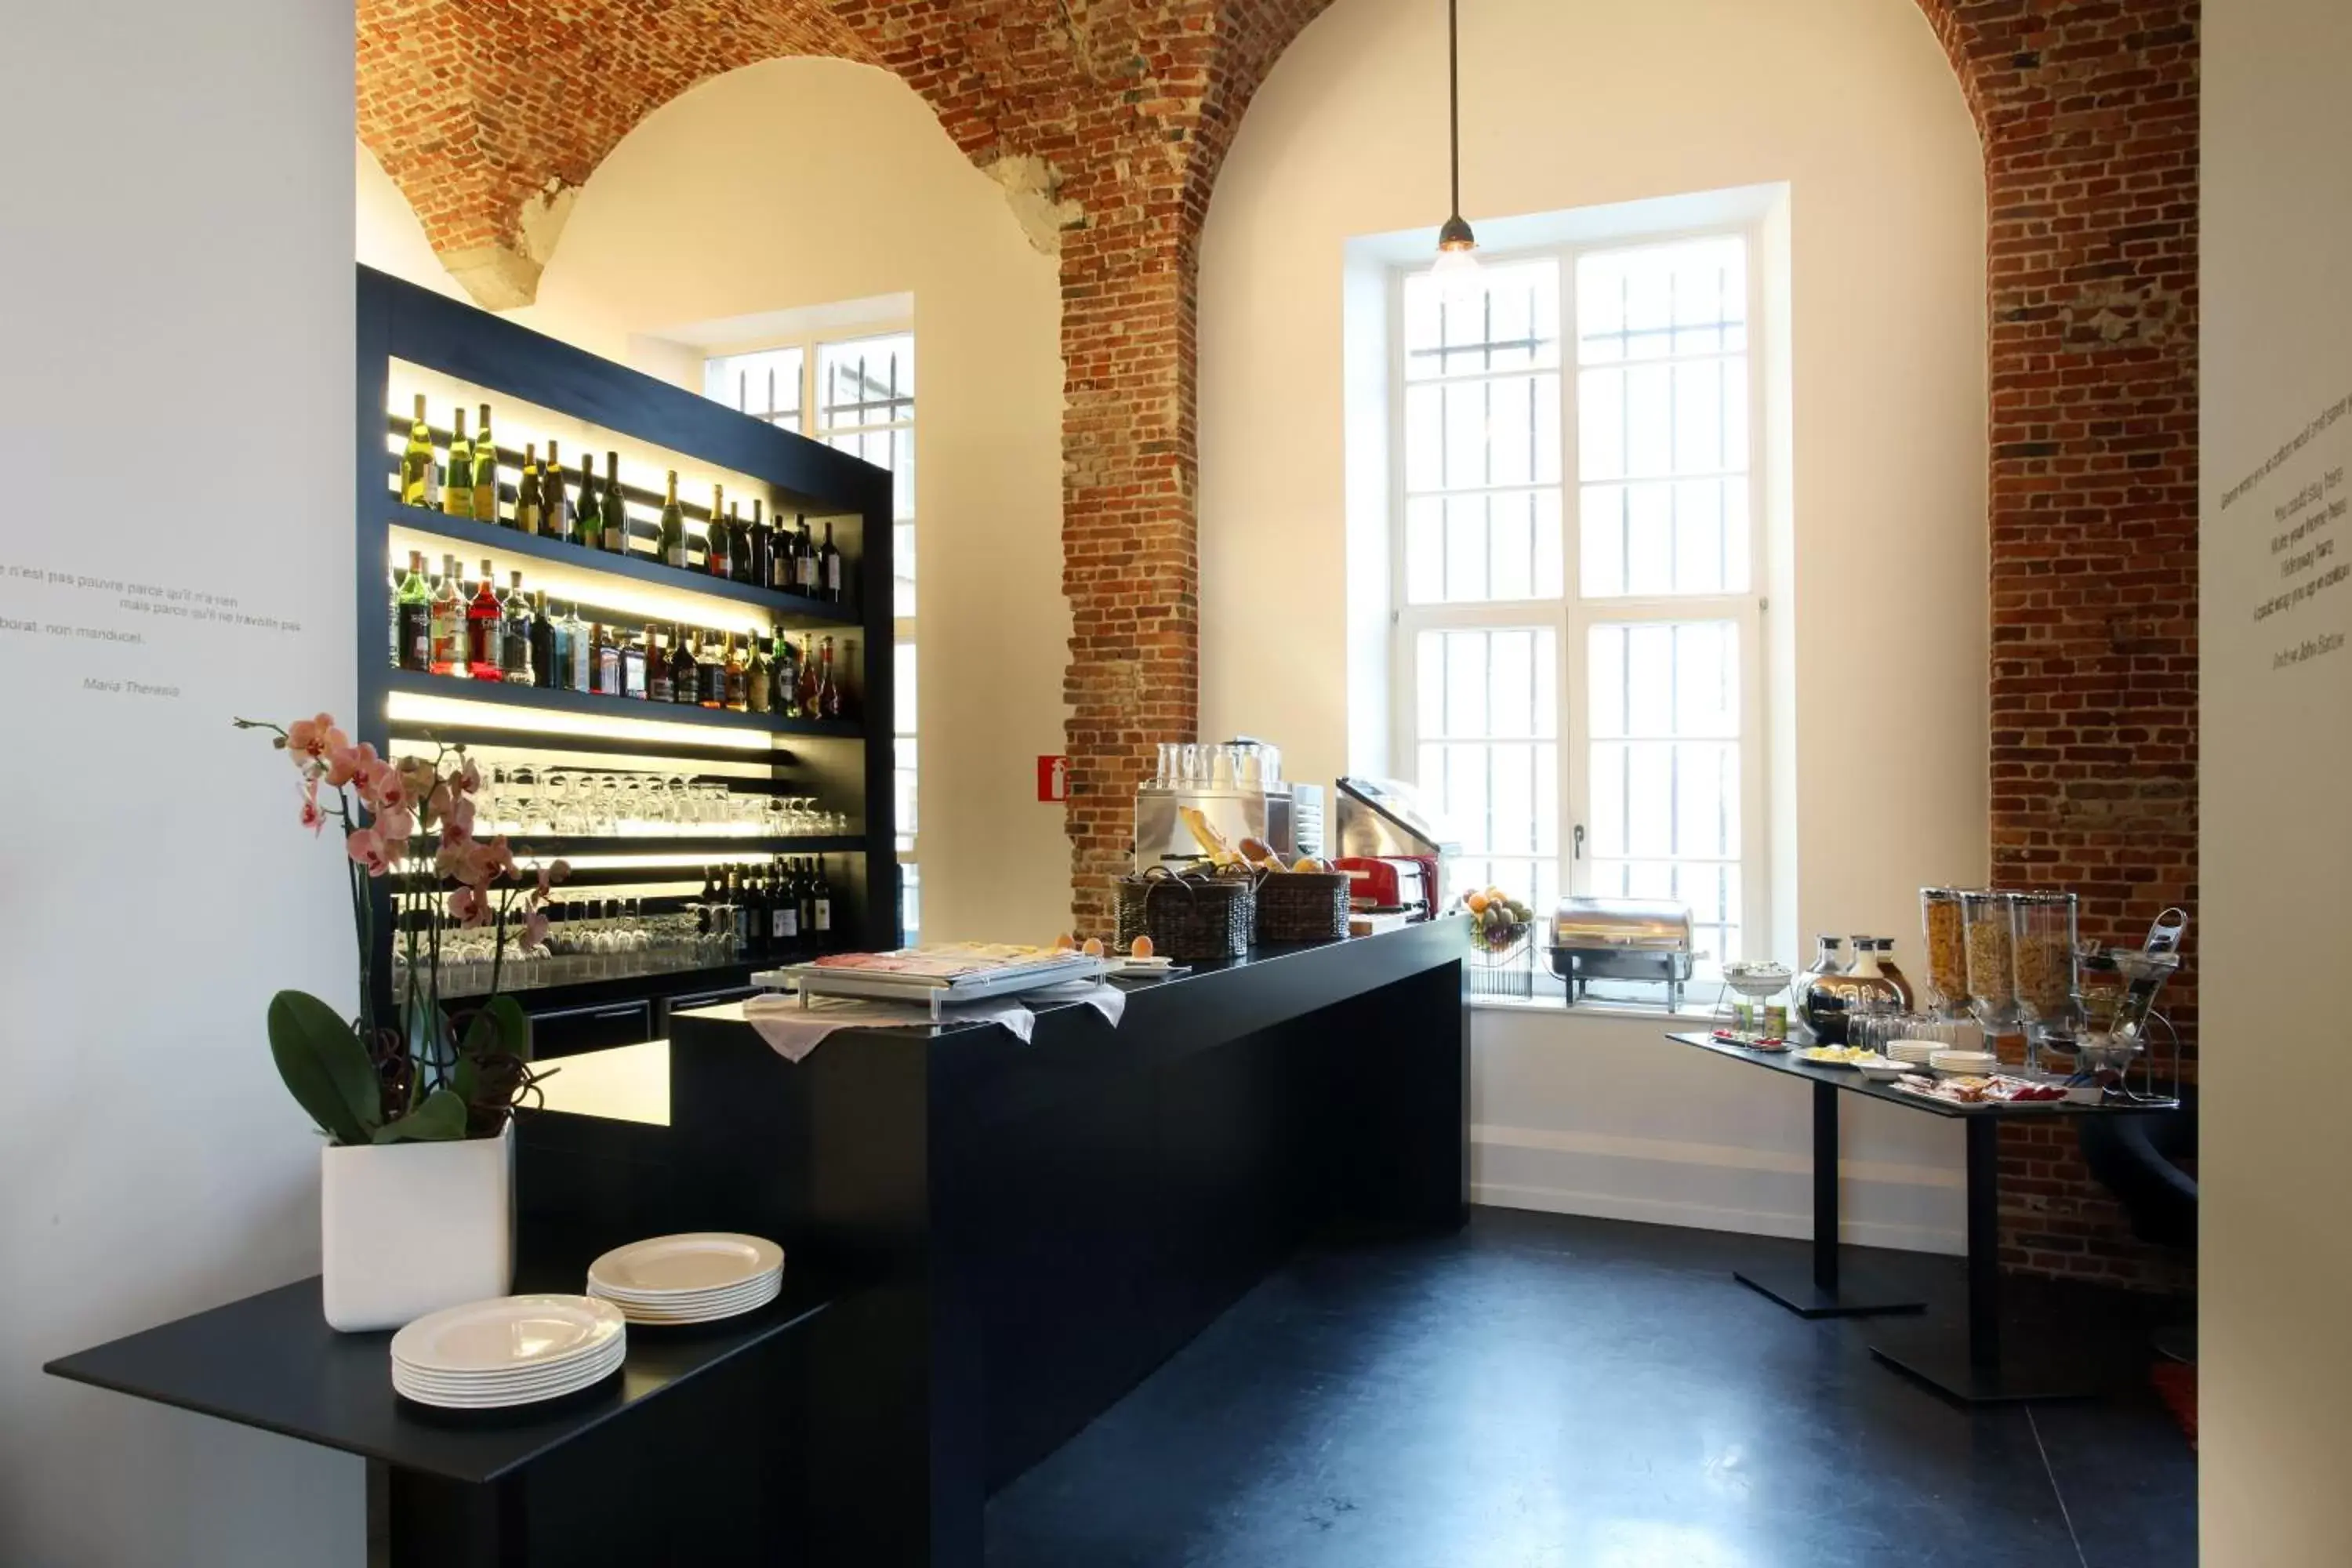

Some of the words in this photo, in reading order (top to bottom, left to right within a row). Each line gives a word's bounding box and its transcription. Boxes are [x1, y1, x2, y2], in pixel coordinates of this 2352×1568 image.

[48, 572, 74, 586] pas
[78, 575, 123, 592] pauvre
[127, 583, 163, 597] parce
[119, 599, 151, 611] mais
[152, 604, 187, 617] parce
[46, 624, 71, 637] non
